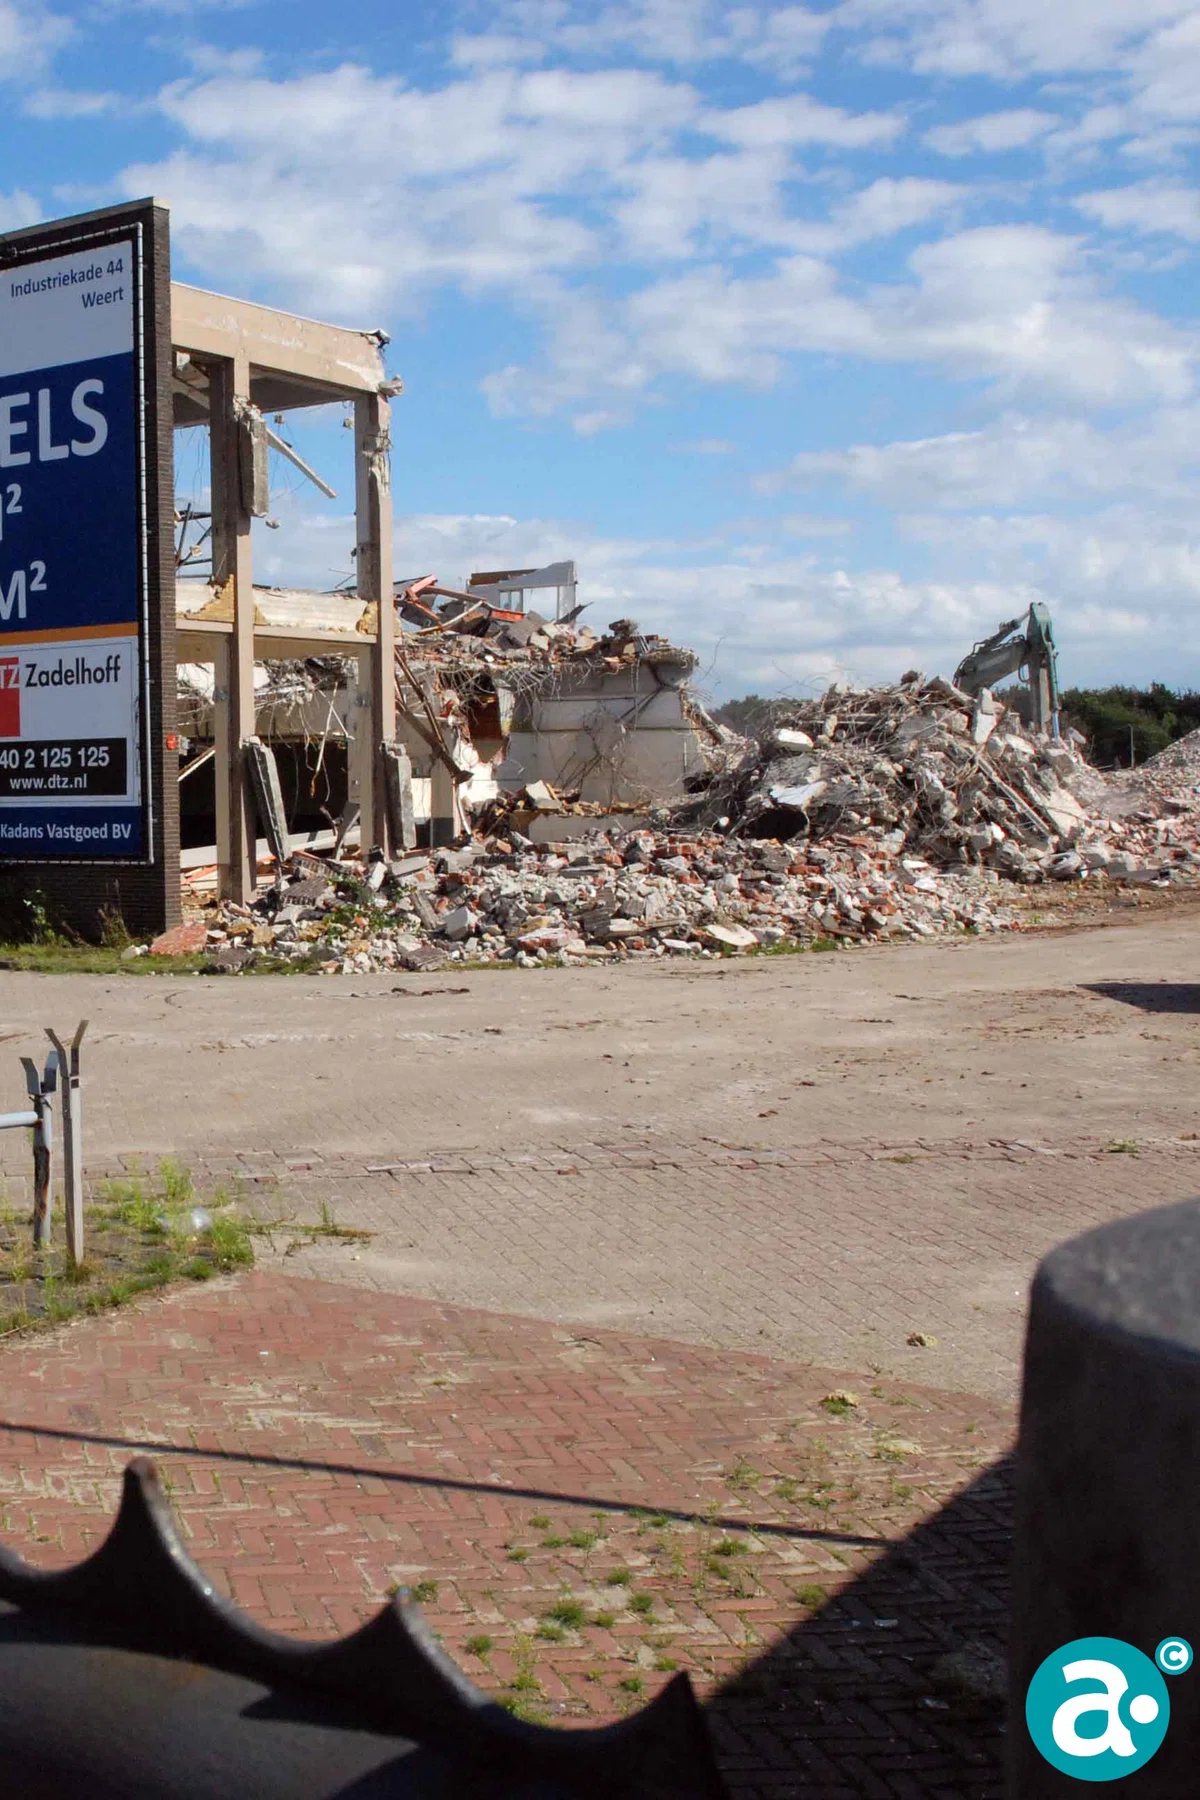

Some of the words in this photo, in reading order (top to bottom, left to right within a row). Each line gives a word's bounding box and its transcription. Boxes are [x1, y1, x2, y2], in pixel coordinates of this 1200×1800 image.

[10, 264, 103, 298] Industriekade
[106, 257, 124, 275] 44
[81, 286, 124, 308] Weert
[25, 654, 121, 688] Zadelhoff
[24, 748, 35, 769] 2
[40, 747, 72, 768] 125
[78, 746, 110, 767] 125
[9, 773, 88, 790] www.dtz.nl
[0, 823, 44, 839] Kadans
[46, 822, 108, 843] Vastgoed
[112, 823, 132, 839] BV
